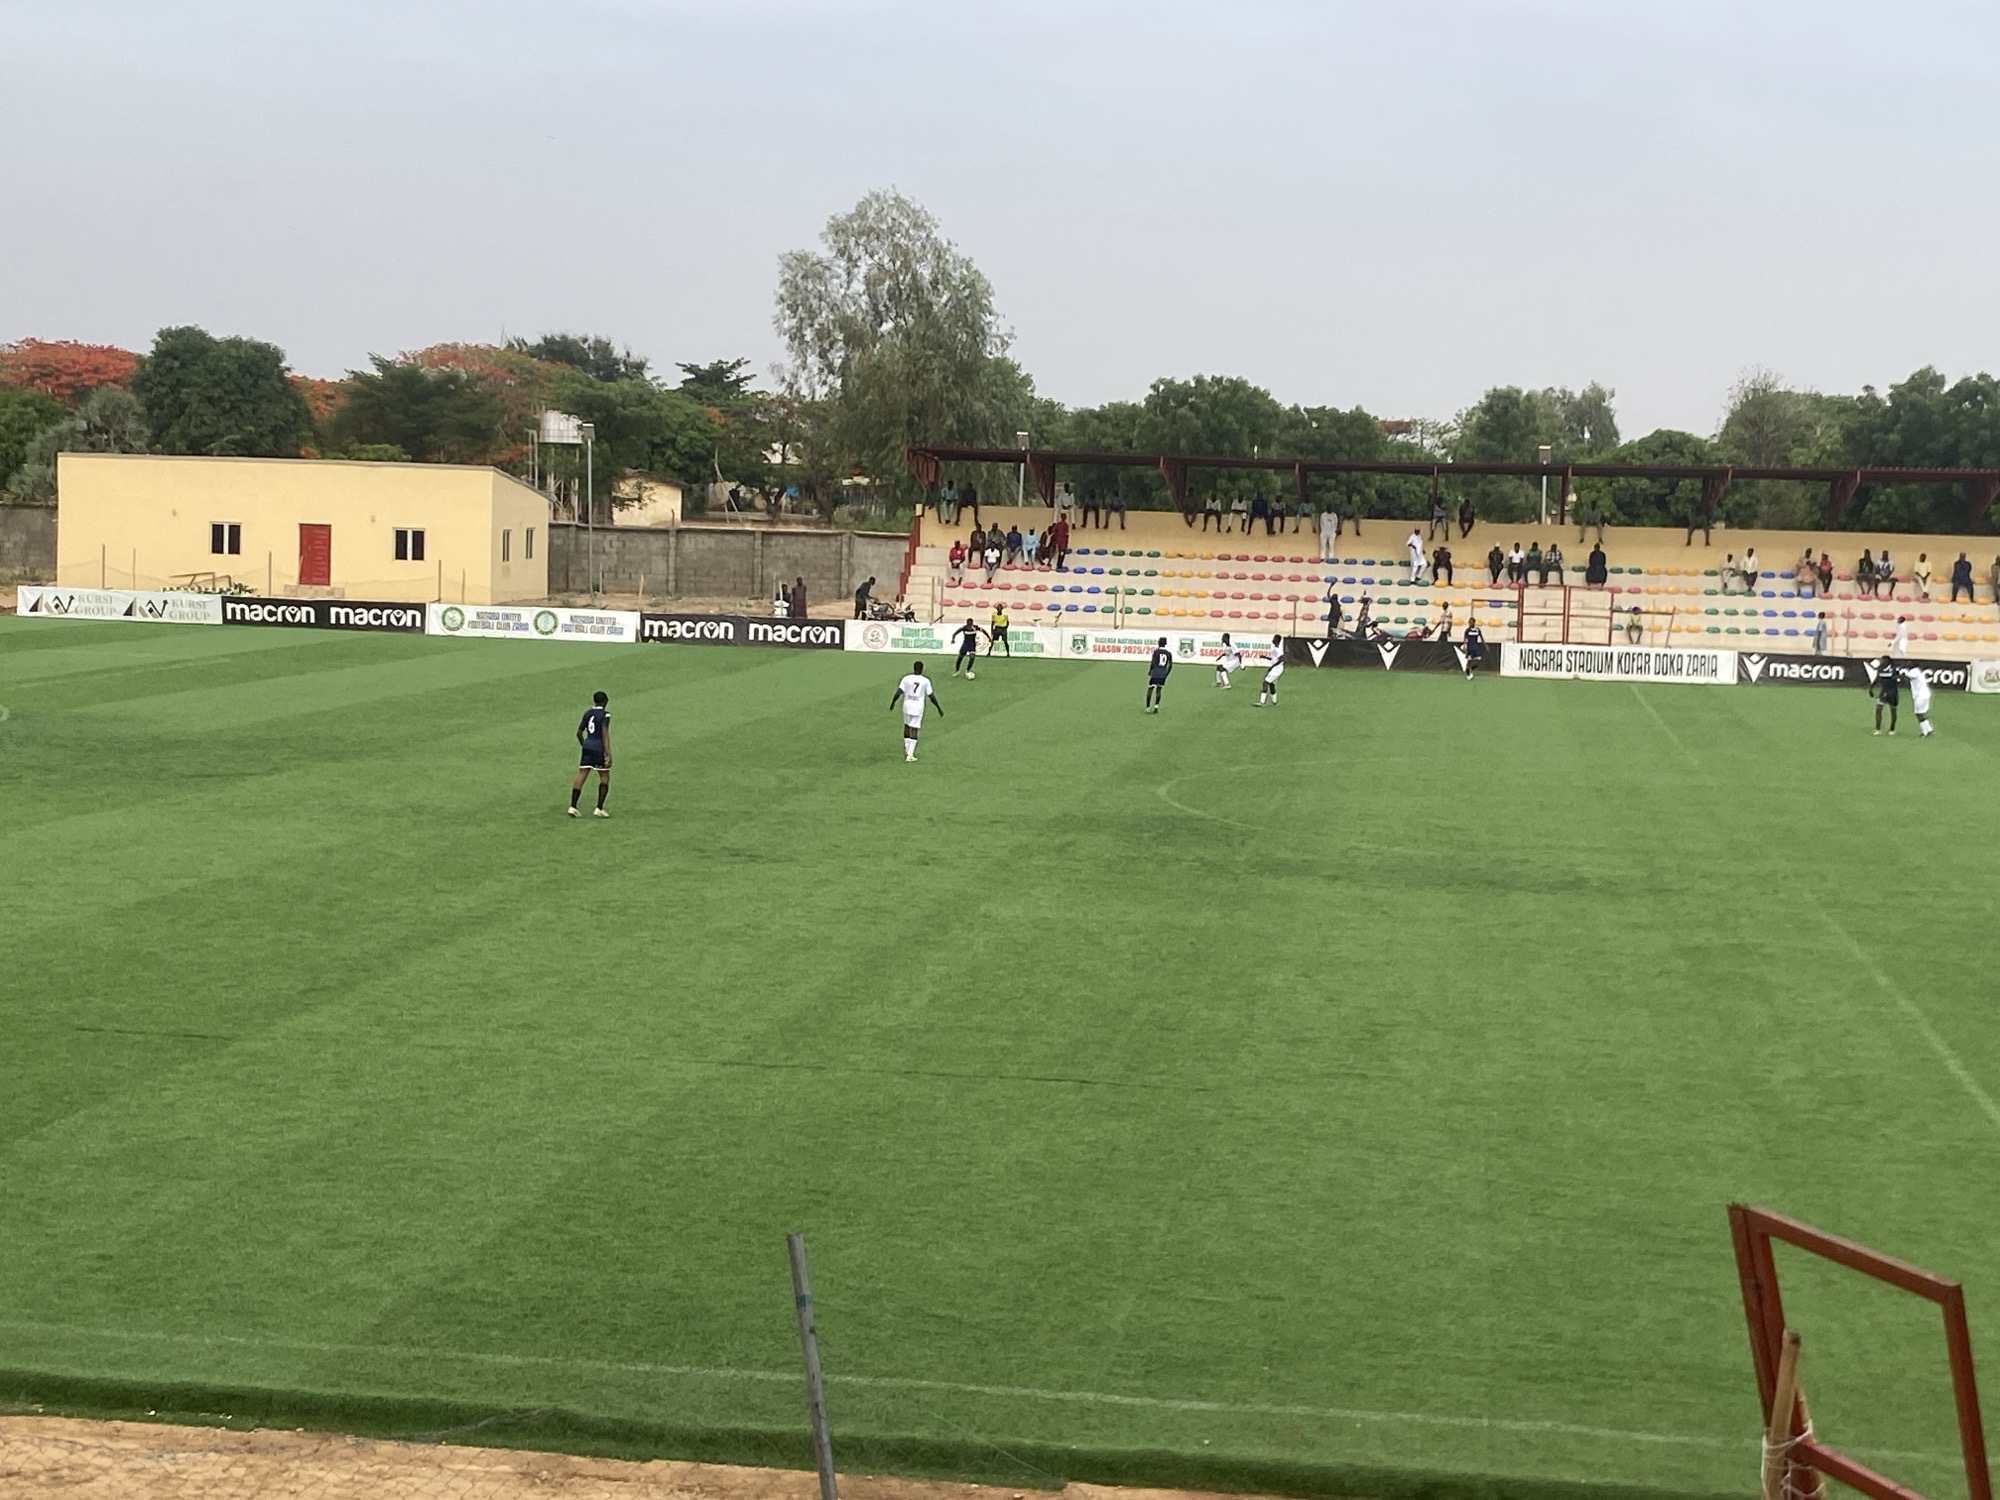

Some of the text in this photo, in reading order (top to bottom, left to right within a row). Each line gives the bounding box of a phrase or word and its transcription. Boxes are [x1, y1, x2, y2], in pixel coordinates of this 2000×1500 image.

[78, 594, 113, 605] KURSI
[172, 599, 207, 609] KURSI
[75, 605, 117, 616] GROUP
[169, 610, 211, 621] GROUP
[226, 602, 315, 624] macron
[330, 606, 421, 627] macron
[644, 619, 734, 640] macron
[749, 622, 841, 644] macron
[1092, 644, 1121, 654] SEASON
[1159, 653, 1168, 667] 10
[1519, 648, 1718, 678] NASARA STADIUM KOFAR DOKA ZARIA
[1769, 662, 1845, 681] macron
[913, 682, 920, 694] 7
[588, 715, 595, 734] 6
